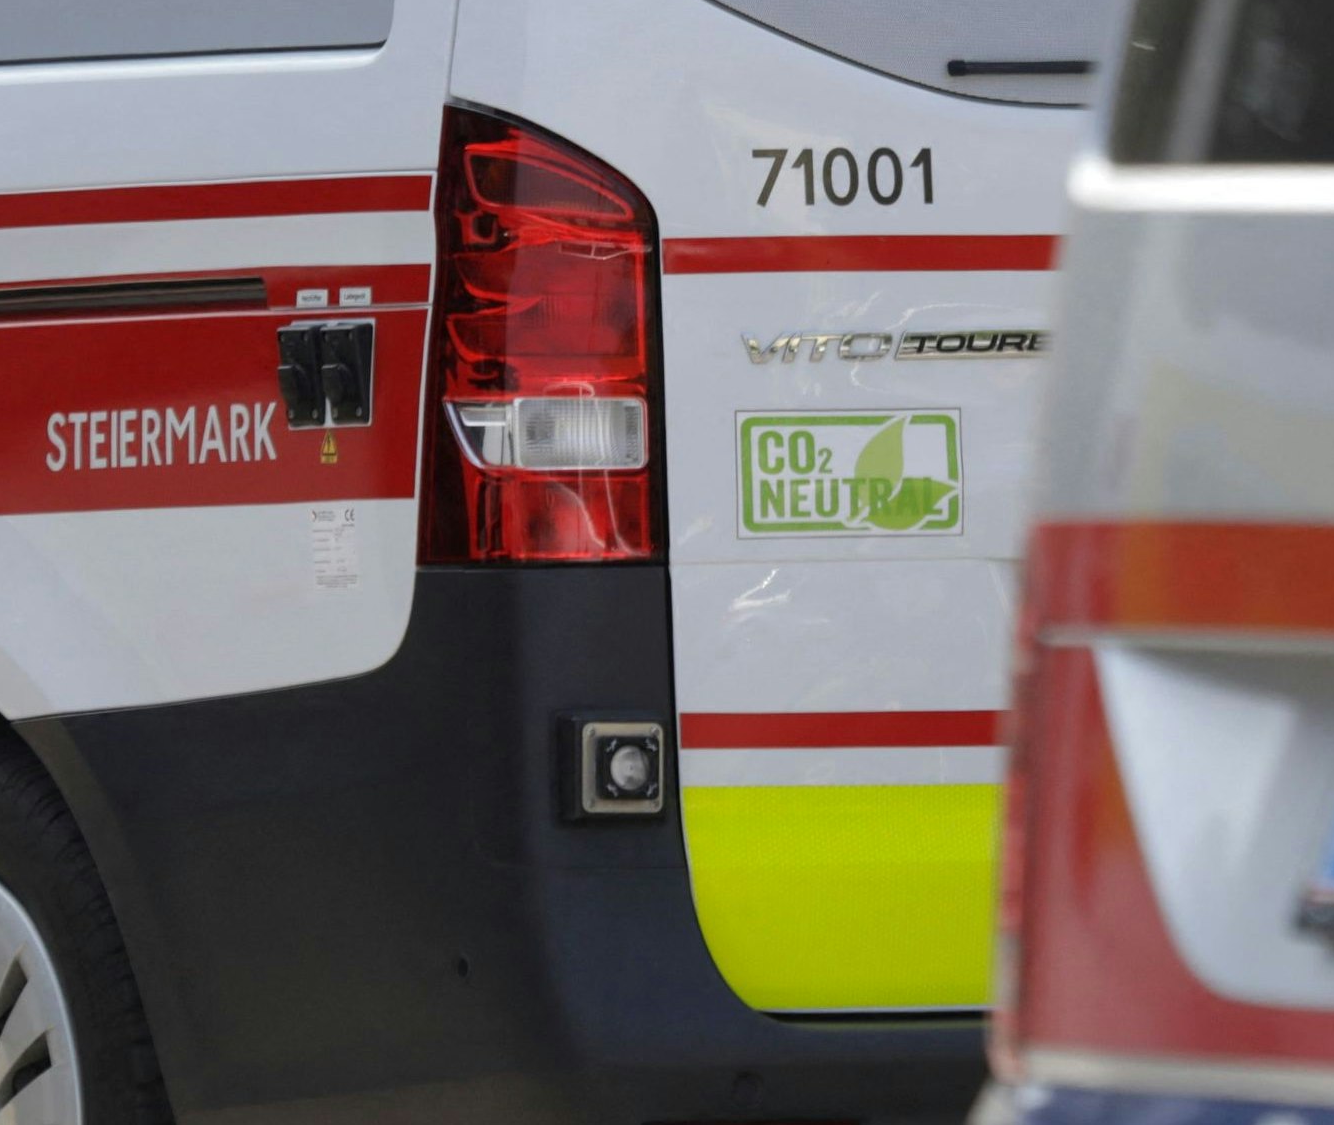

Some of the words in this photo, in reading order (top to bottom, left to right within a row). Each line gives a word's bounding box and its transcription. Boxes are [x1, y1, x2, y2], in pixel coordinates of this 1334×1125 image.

[752, 147, 934, 207] 71001
[740, 329, 893, 365] VITO
[907, 332, 1055, 355] TOURE
[46, 401, 278, 473] STEIERMARK
[759, 477, 944, 519] NEUTRAL
